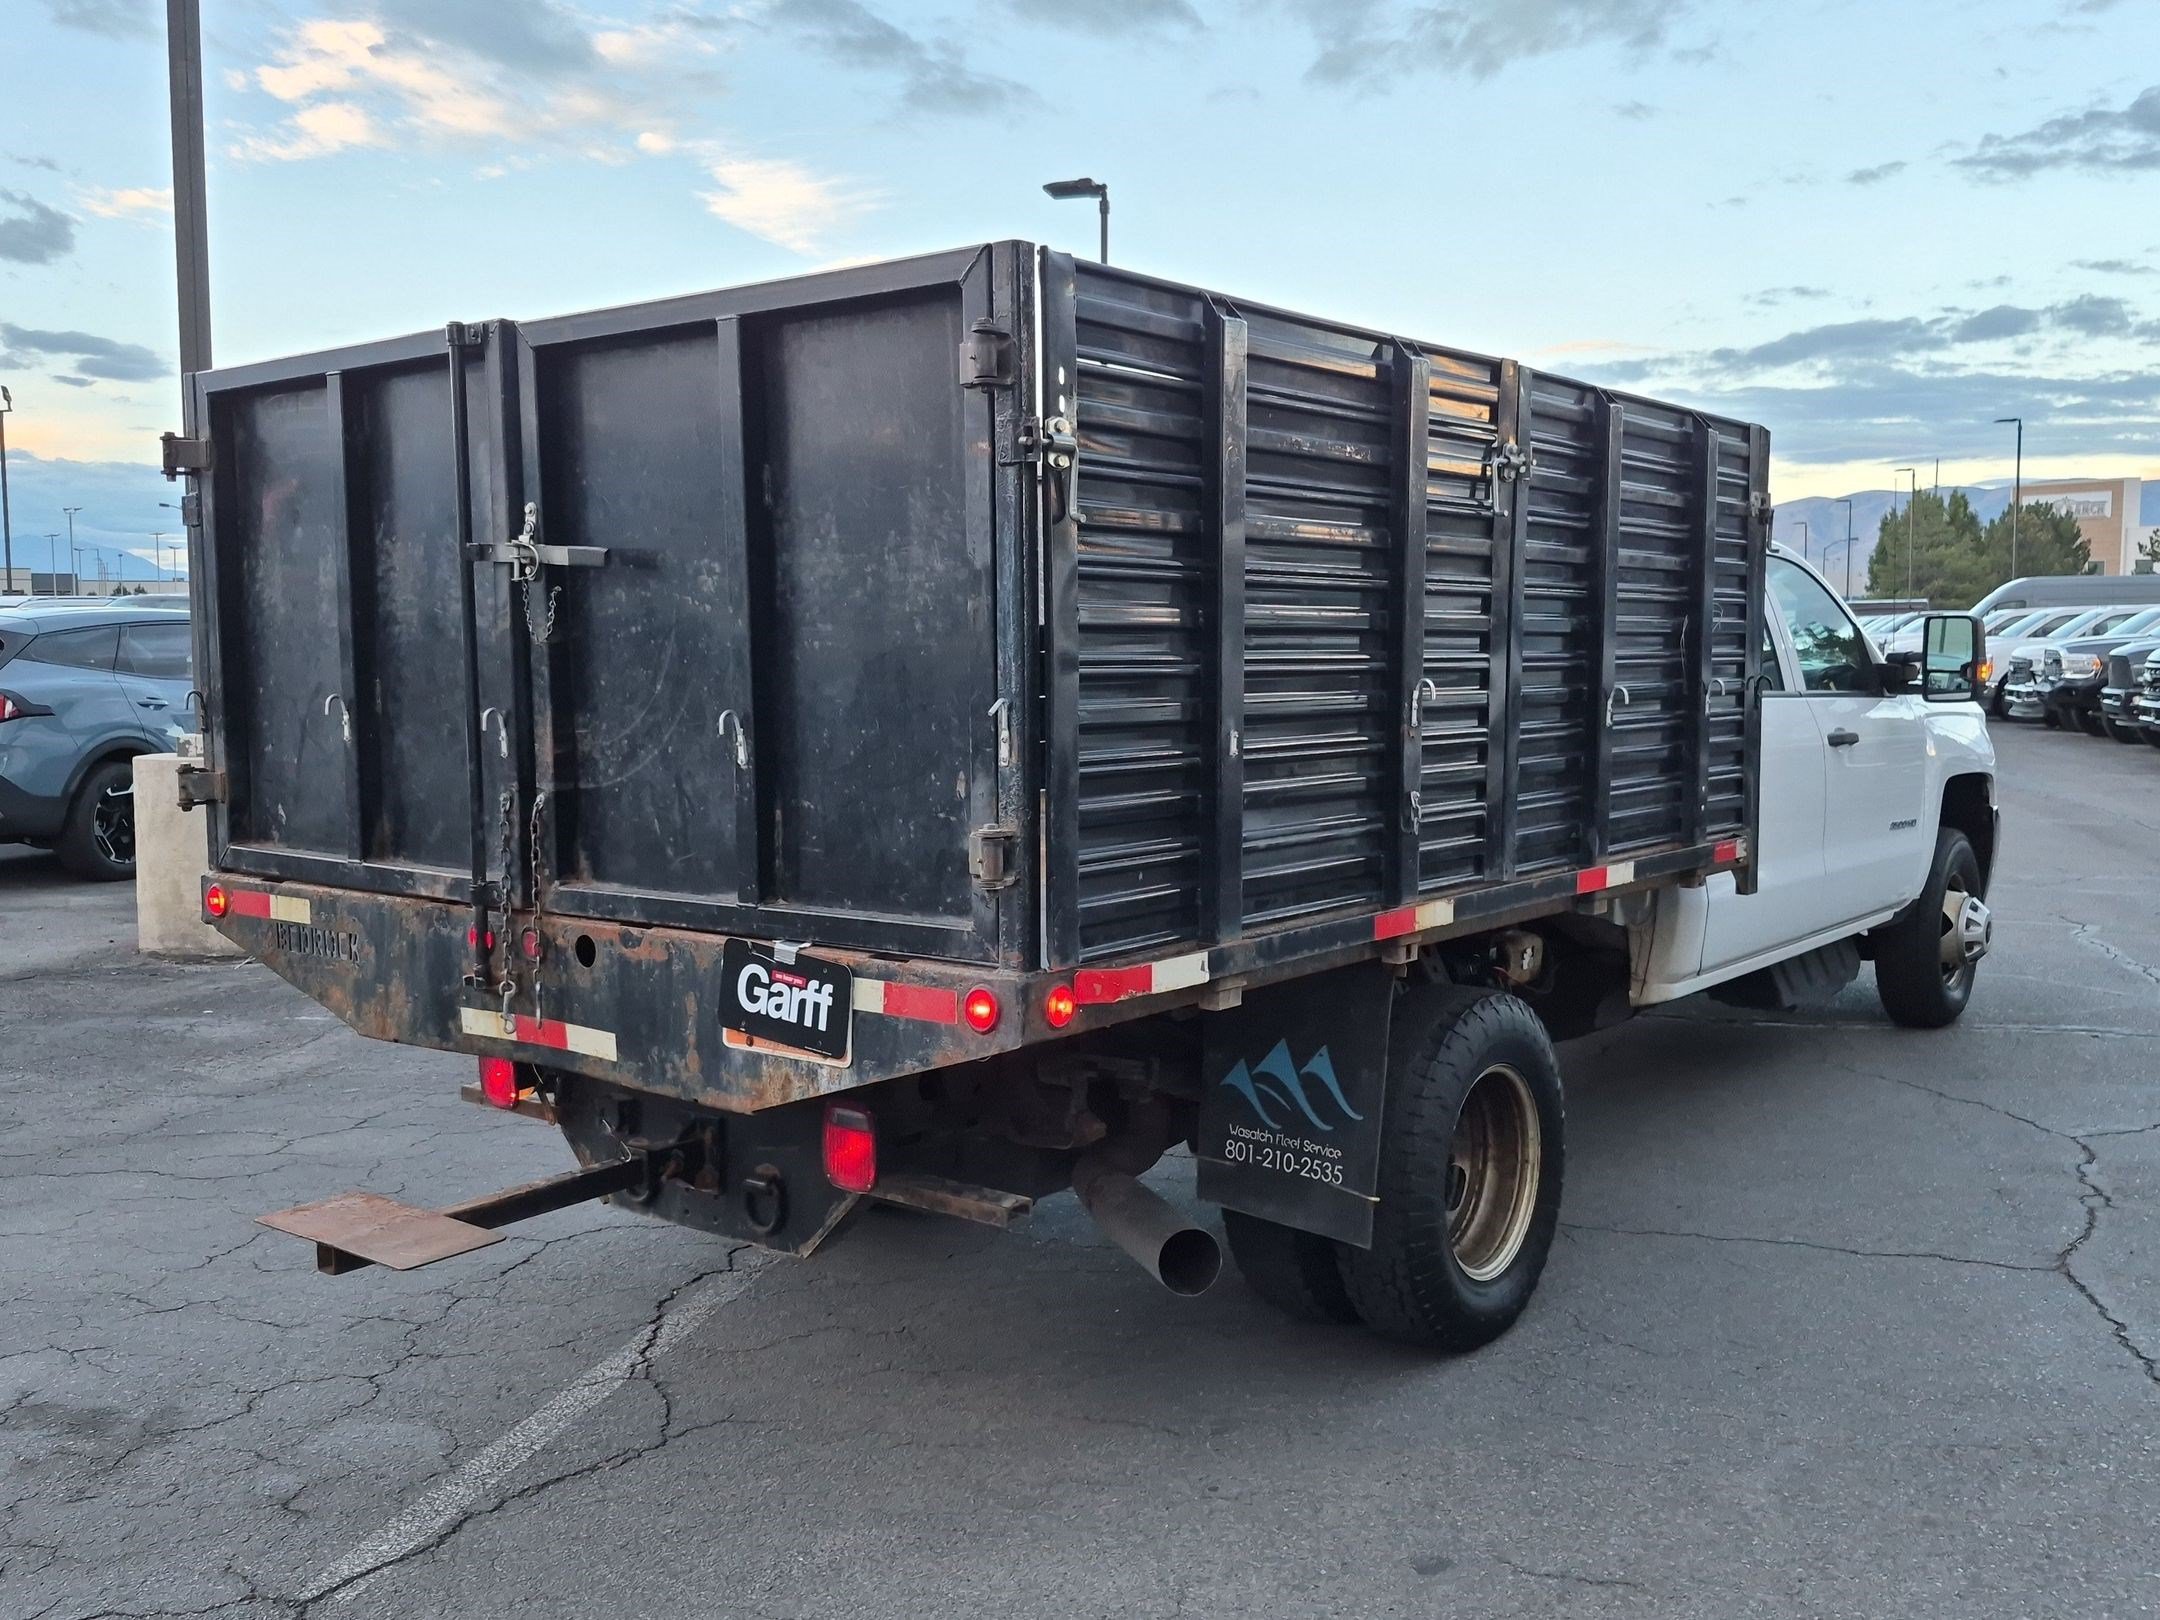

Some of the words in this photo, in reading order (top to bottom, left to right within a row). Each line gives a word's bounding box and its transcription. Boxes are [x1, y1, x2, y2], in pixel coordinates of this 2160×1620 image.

[276, 922, 360, 967] BEDROCK
[737, 963, 834, 1032] Garff
[1225, 1139, 1344, 1185] 801-210-2535
[1229, 1123, 1273, 1143] Wasatch
[1303, 1139, 1342, 1159] Service
